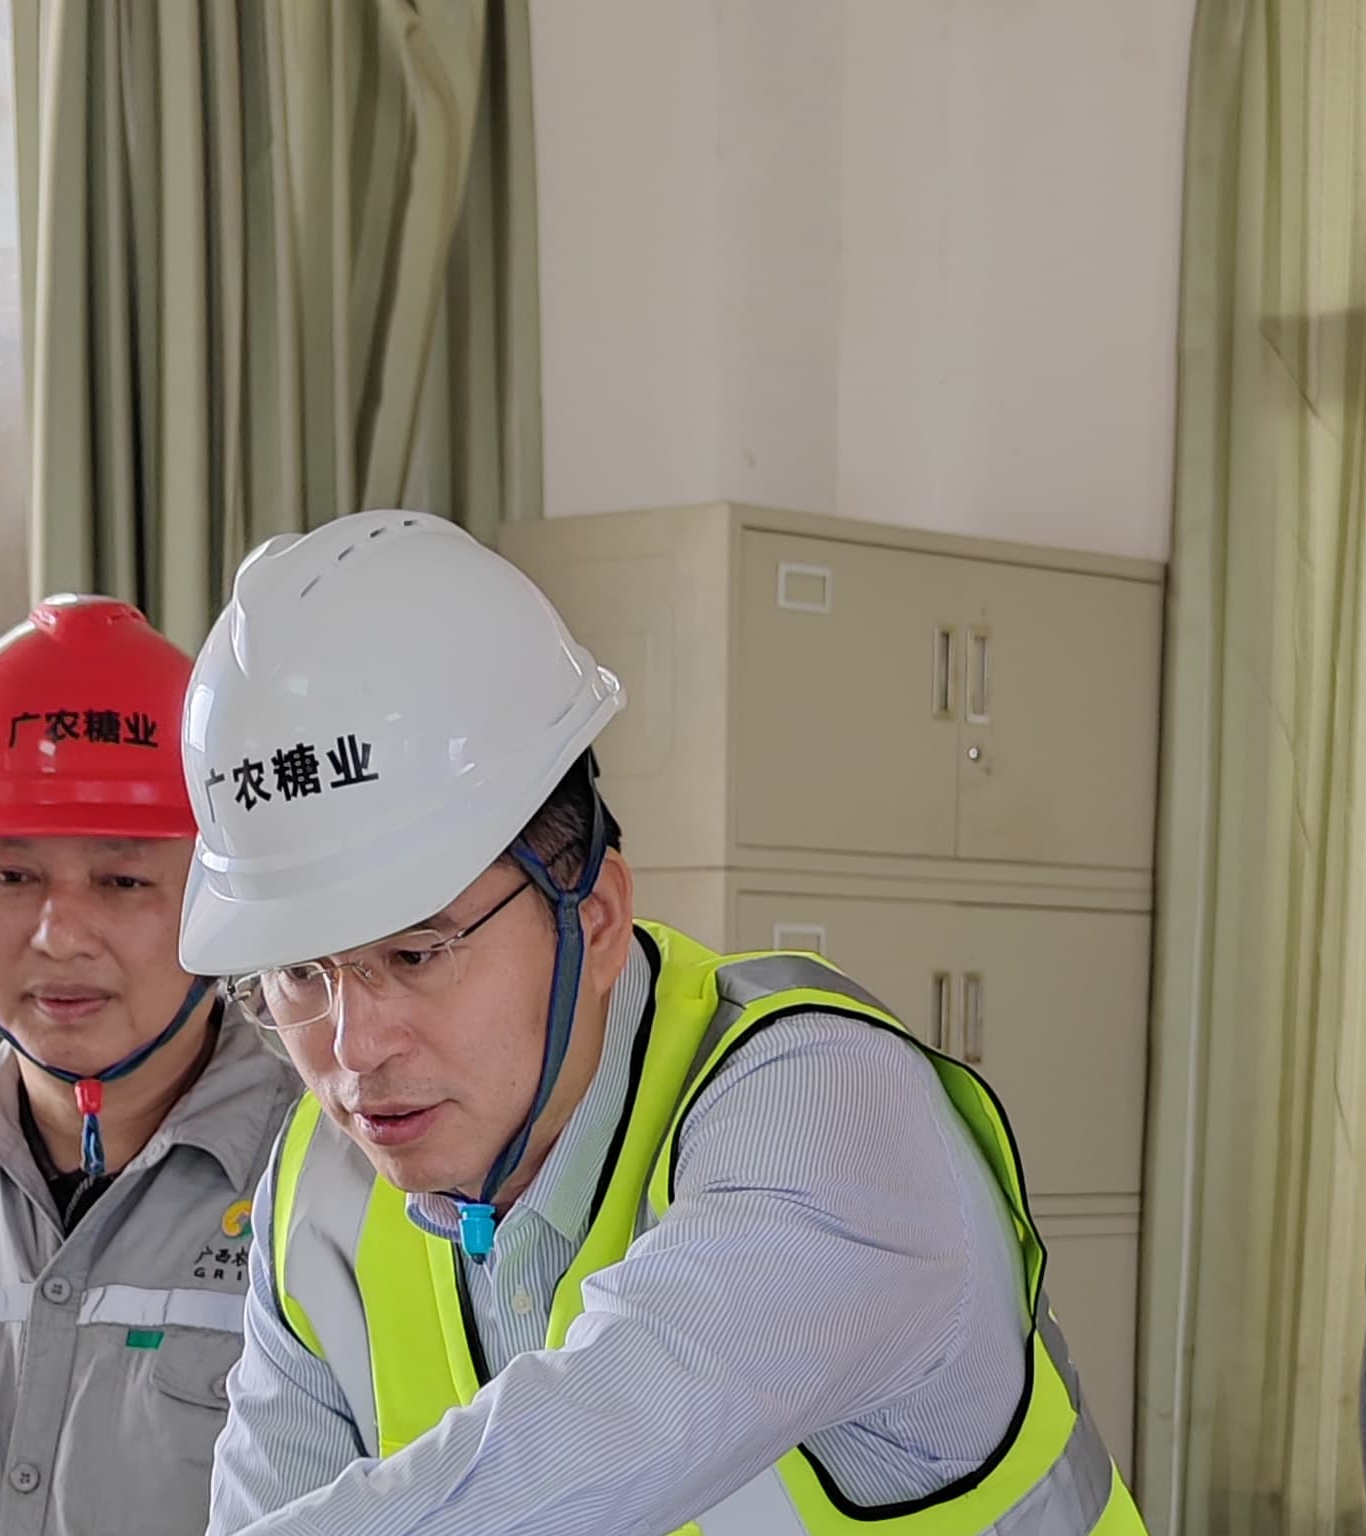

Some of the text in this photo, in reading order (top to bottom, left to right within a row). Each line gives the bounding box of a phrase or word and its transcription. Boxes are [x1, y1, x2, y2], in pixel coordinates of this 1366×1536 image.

[8, 708, 159, 749] 广农糖业
[203, 733, 380, 824] 广农糖业
